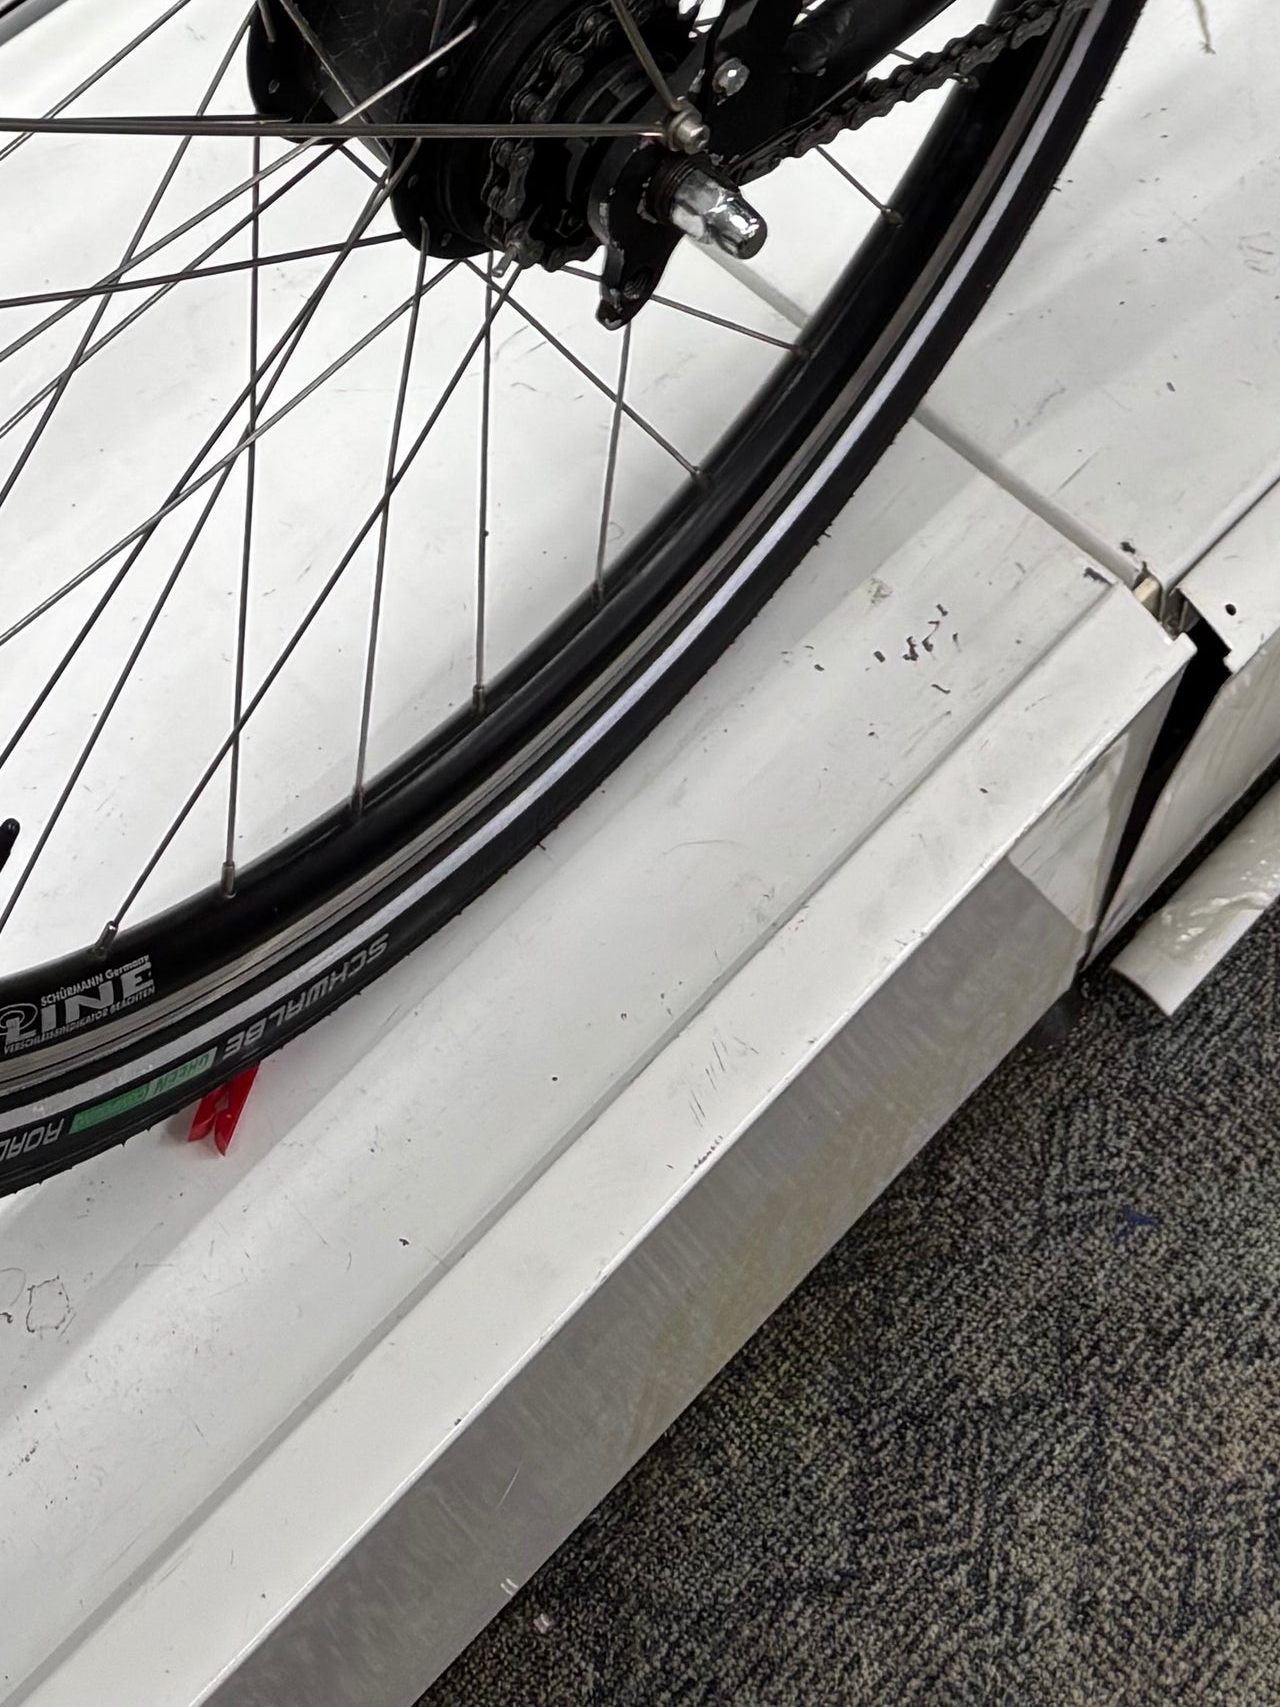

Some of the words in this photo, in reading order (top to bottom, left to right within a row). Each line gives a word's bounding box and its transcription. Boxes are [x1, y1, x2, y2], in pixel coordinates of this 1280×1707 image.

[40, 973, 104, 1007] SCHÜRMANN
[105, 954, 151, 982] Germany
[221, 932, 390, 1060] SCHWALBE
